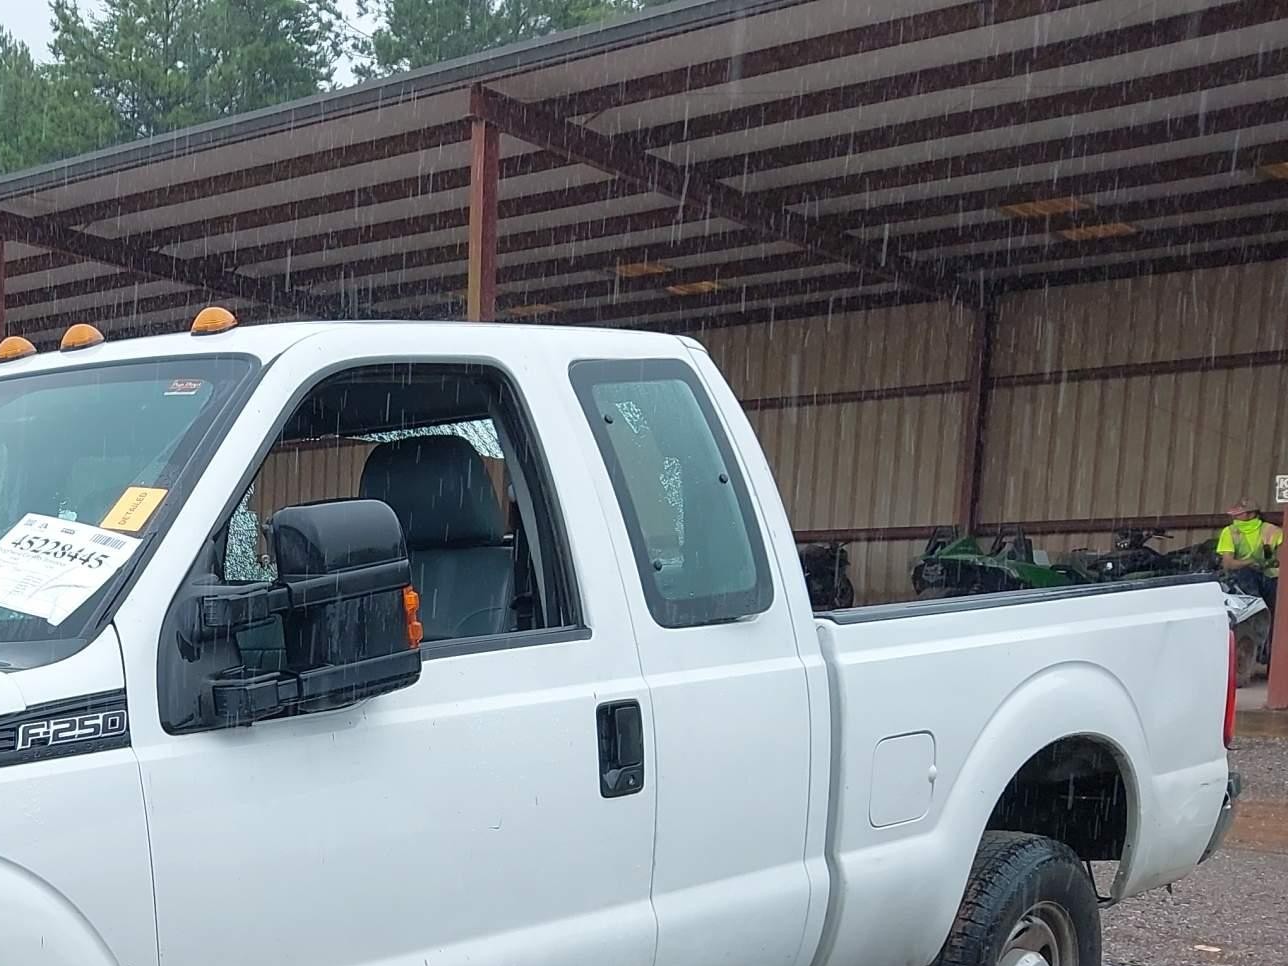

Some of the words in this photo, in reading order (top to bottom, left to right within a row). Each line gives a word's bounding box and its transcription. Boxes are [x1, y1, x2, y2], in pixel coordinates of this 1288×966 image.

[118, 492, 148, 525] DETAILED
[11, 534, 109, 569] 45228445
[16, 711, 127, 750] F-250
